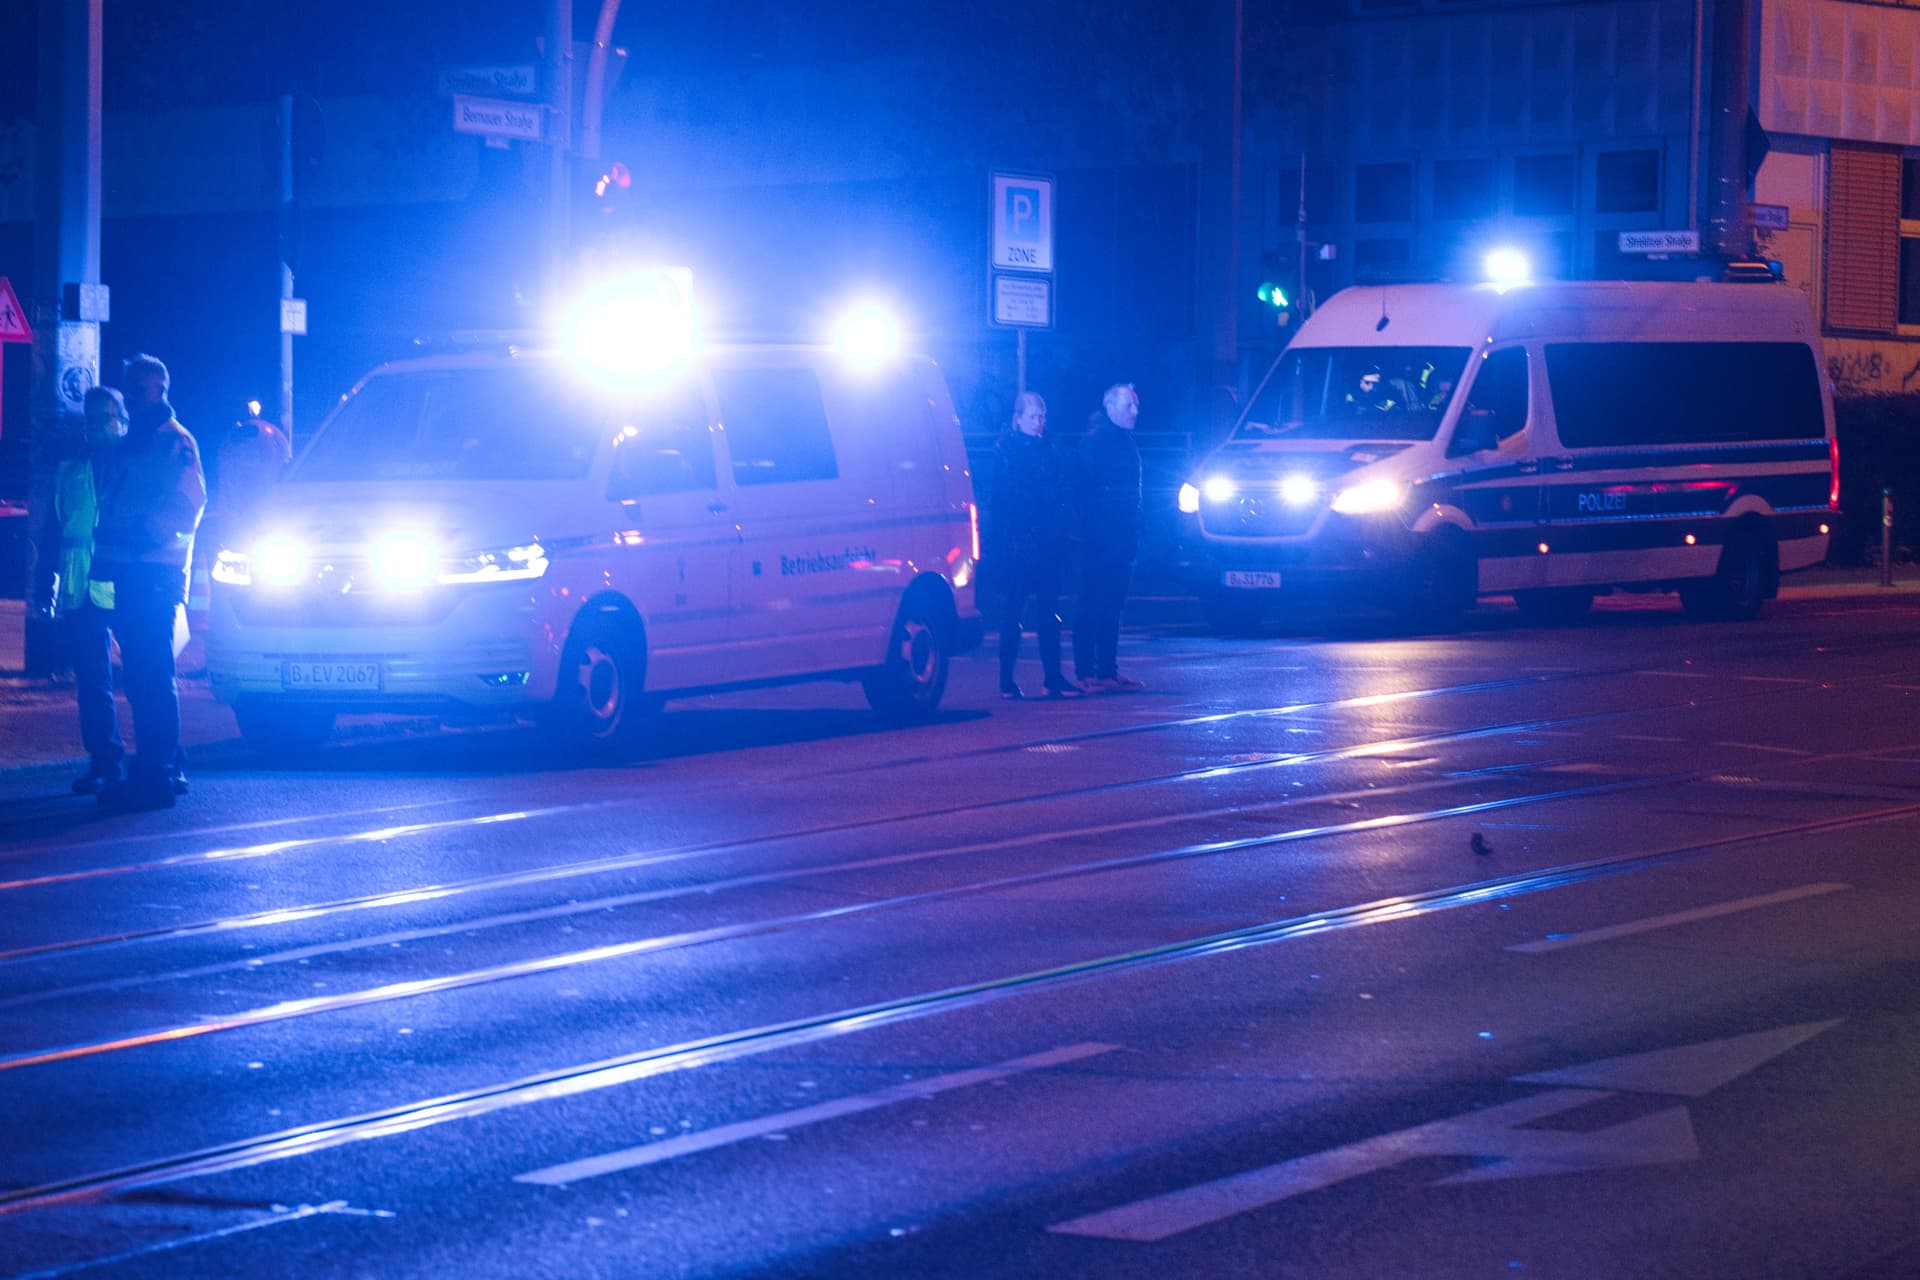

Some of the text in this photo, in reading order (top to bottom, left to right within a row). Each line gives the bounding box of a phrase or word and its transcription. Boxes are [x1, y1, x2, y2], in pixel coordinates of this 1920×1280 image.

[1013, 193, 1033, 234] P
[1008, 246, 1038, 264] ZONE
[1578, 492, 1627, 512] POLIZEI
[292, 664, 377, 683] B EV 2067
